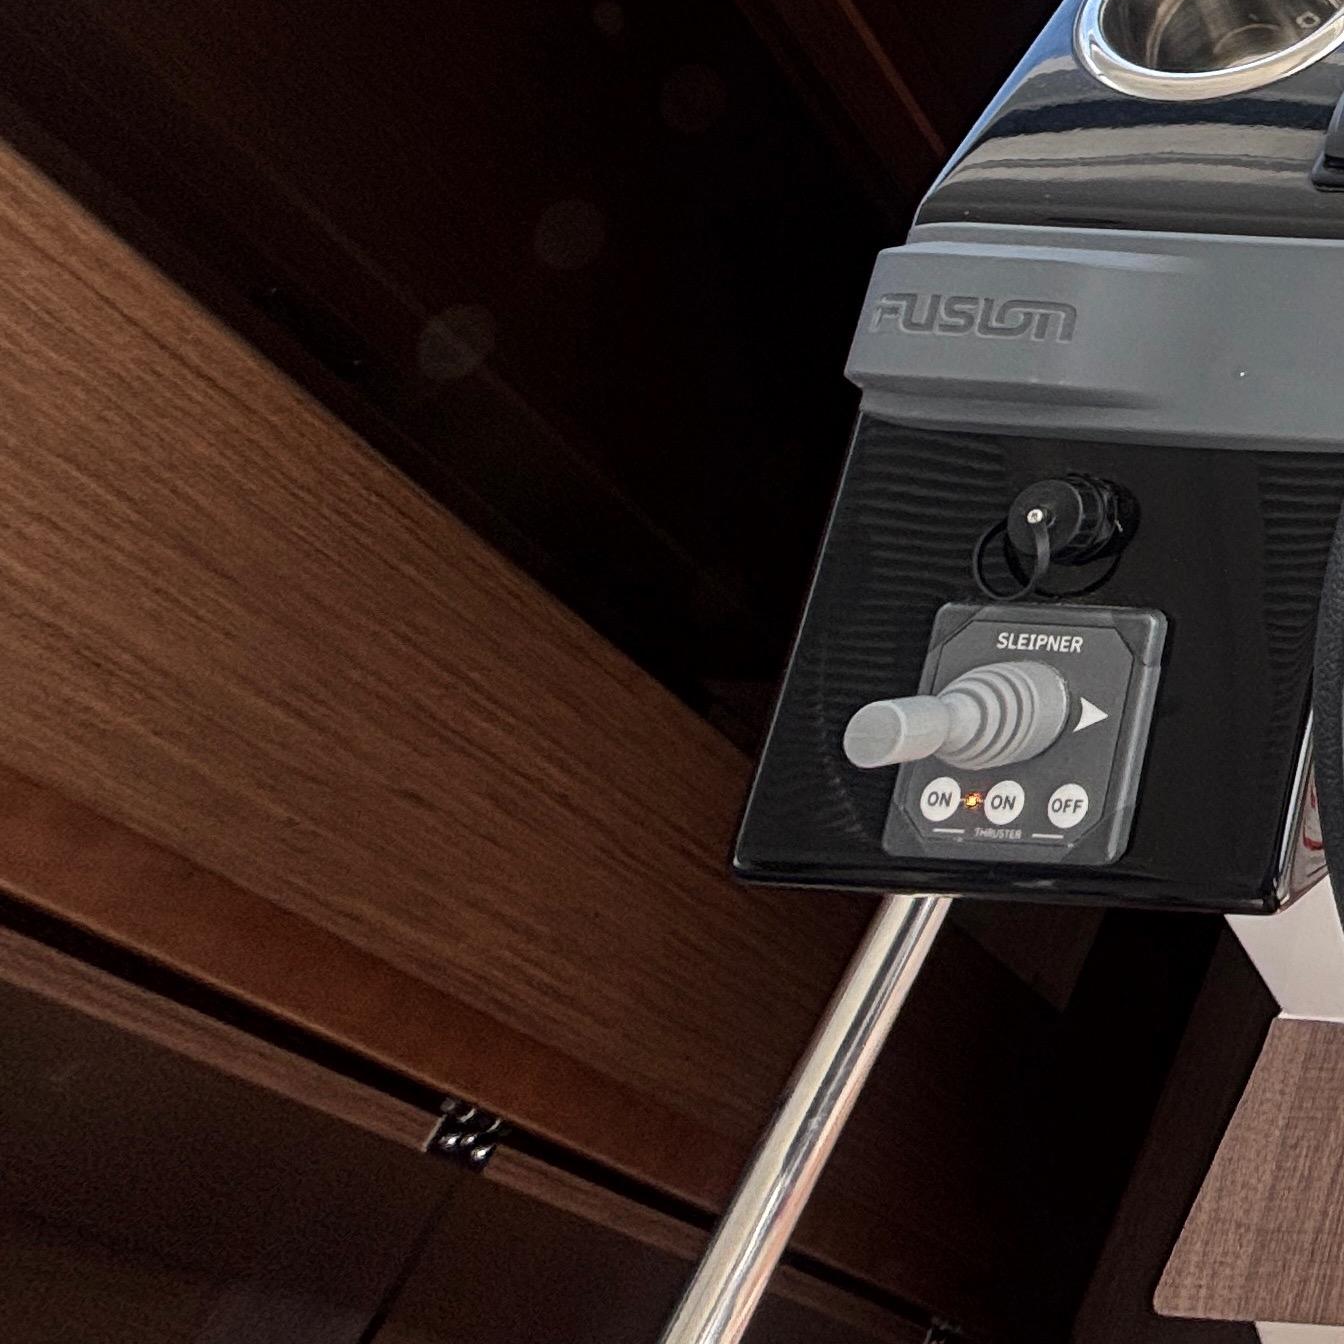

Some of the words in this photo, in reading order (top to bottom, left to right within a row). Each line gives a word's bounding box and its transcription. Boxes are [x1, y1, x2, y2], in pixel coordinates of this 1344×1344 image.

[868, 291, 1079, 345] FUSION
[997, 631, 1084, 653] SLEIPNER
[927, 790, 953, 807] ON
[990, 794, 1016, 811] ON
[1050, 797, 1084, 814] OFF
[974, 827, 1023, 840] THRUSTER
